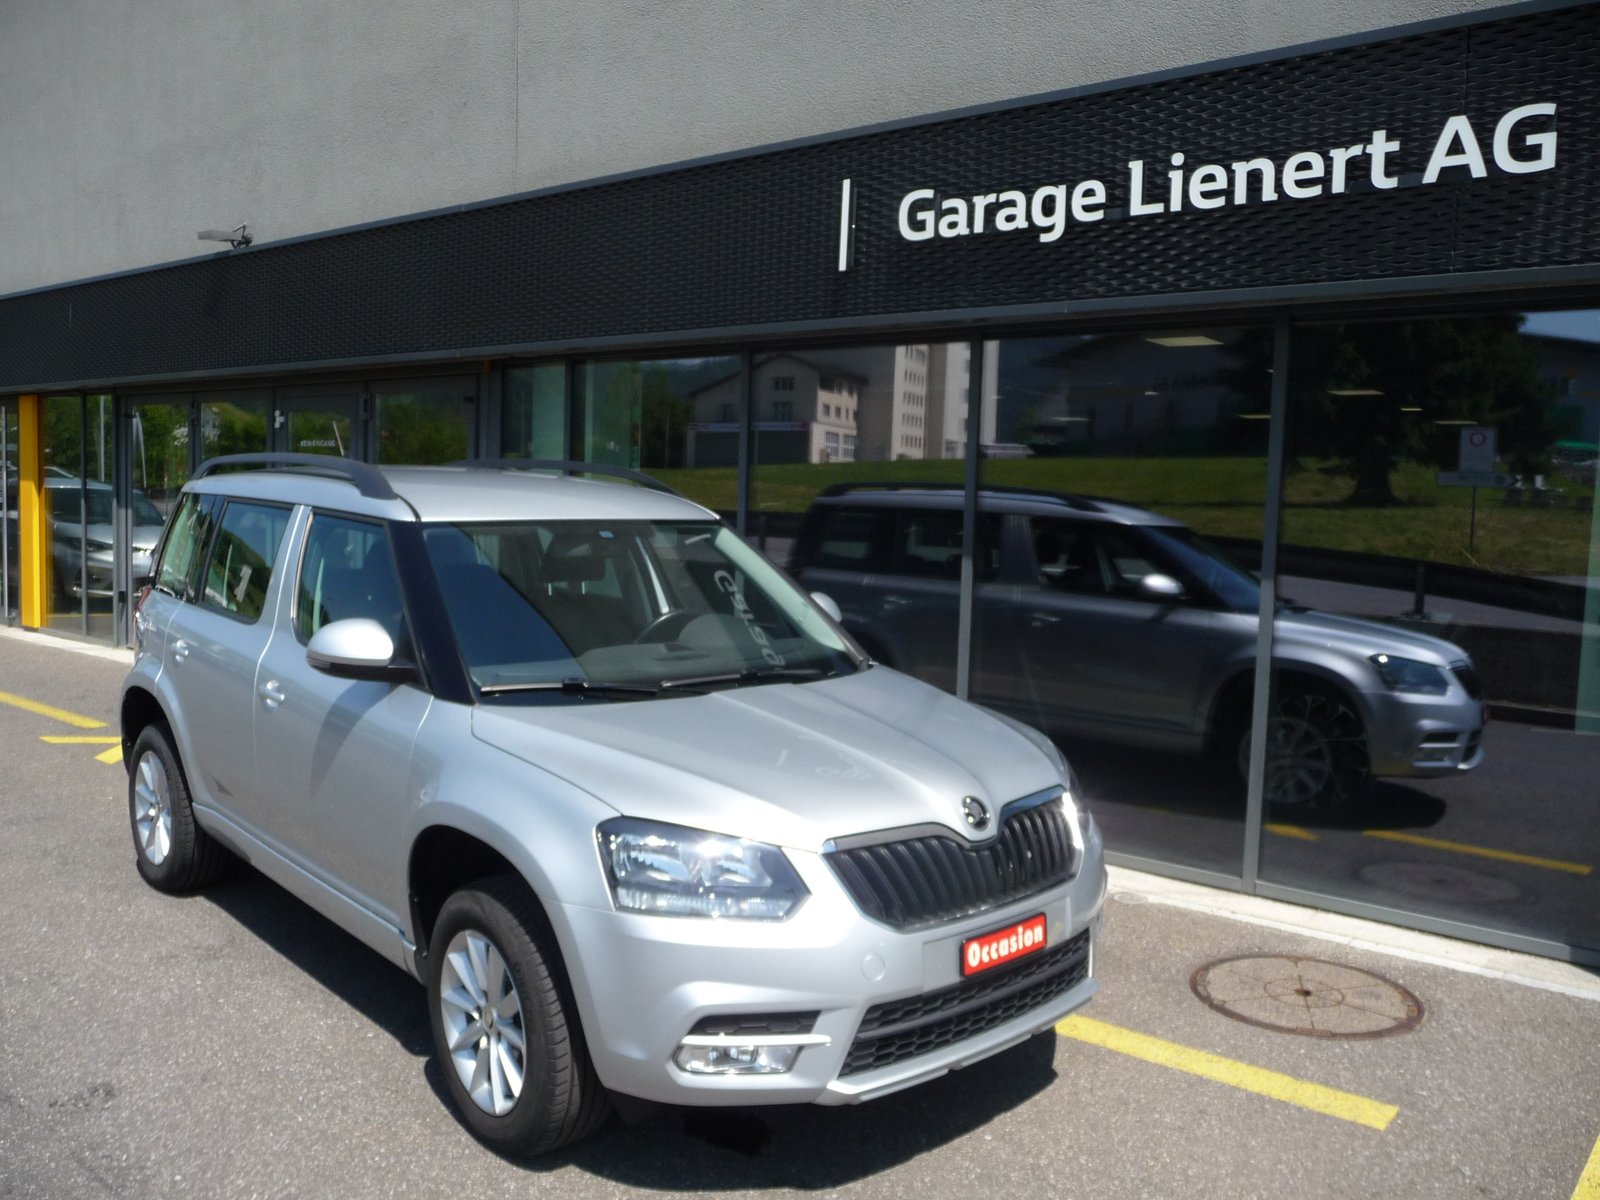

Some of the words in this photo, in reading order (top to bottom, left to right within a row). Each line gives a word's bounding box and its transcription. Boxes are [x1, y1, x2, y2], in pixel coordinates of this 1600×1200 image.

[899, 180, 1106, 242] Garage
[1129, 130, 1400, 216] Lienert
[1422, 103, 1557, 184] AG
[967, 925, 1044, 967] Occasion
